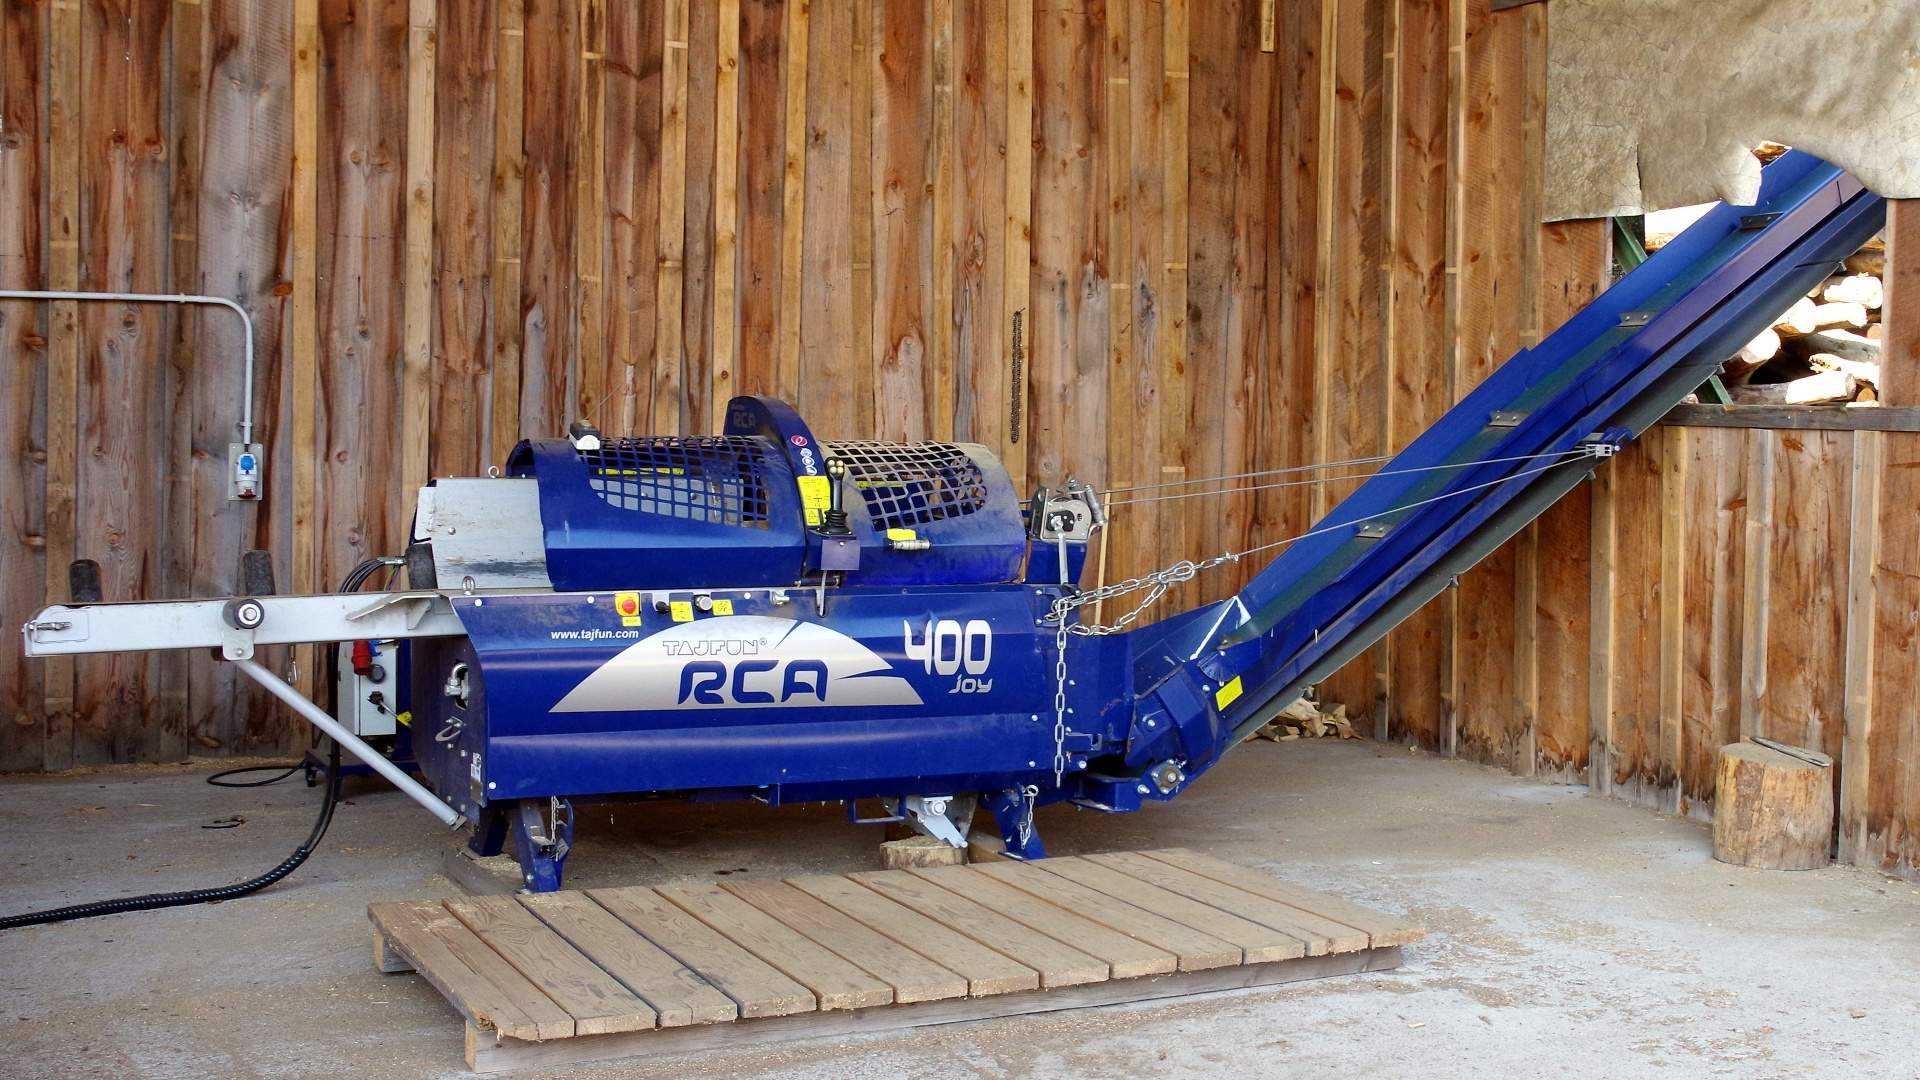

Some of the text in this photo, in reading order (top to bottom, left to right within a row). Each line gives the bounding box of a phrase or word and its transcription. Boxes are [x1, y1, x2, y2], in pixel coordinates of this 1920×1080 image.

[551, 628, 639, 641] www.tajfun.com
[903, 619, 992, 676] 400
[677, 659, 829, 705] RCA
